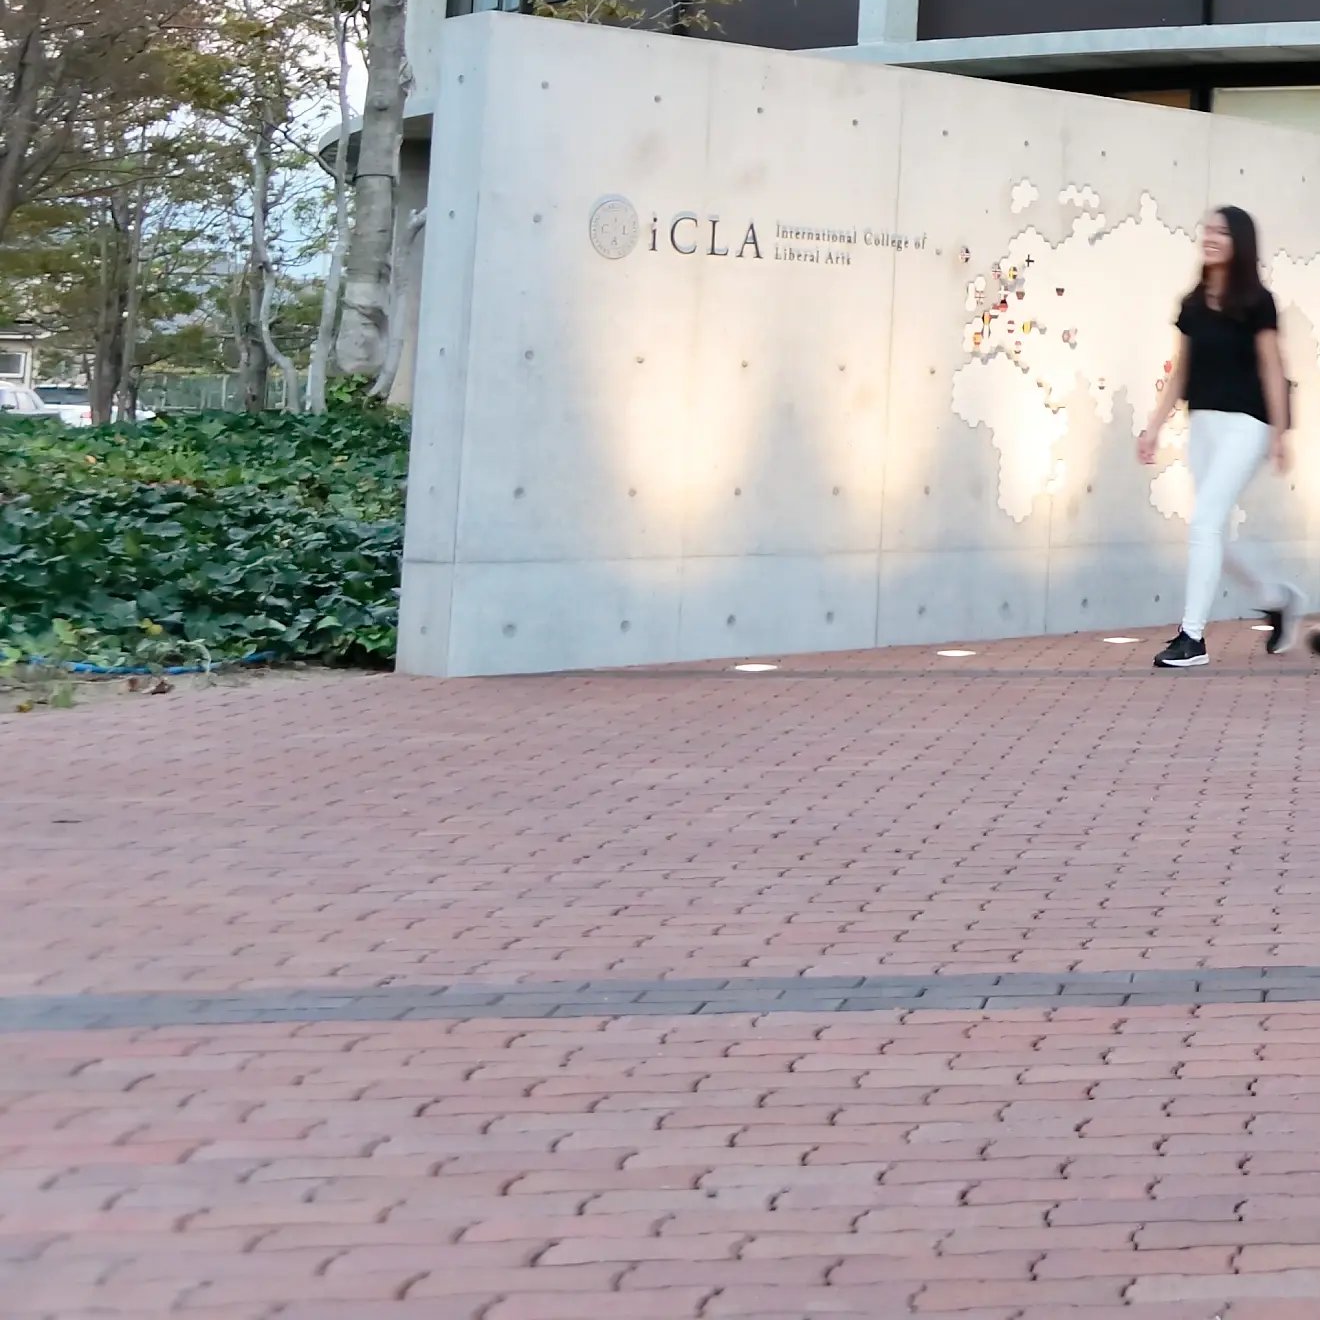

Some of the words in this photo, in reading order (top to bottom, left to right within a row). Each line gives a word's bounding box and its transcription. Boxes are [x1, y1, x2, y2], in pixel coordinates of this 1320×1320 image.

[649, 217, 763, 259] iCLA
[776, 224, 857, 244] International
[864, 231, 909, 253] College
[914, 232, 928, 251] of
[774, 247, 820, 265] Liberal
[825, 251, 852, 266] Arts
